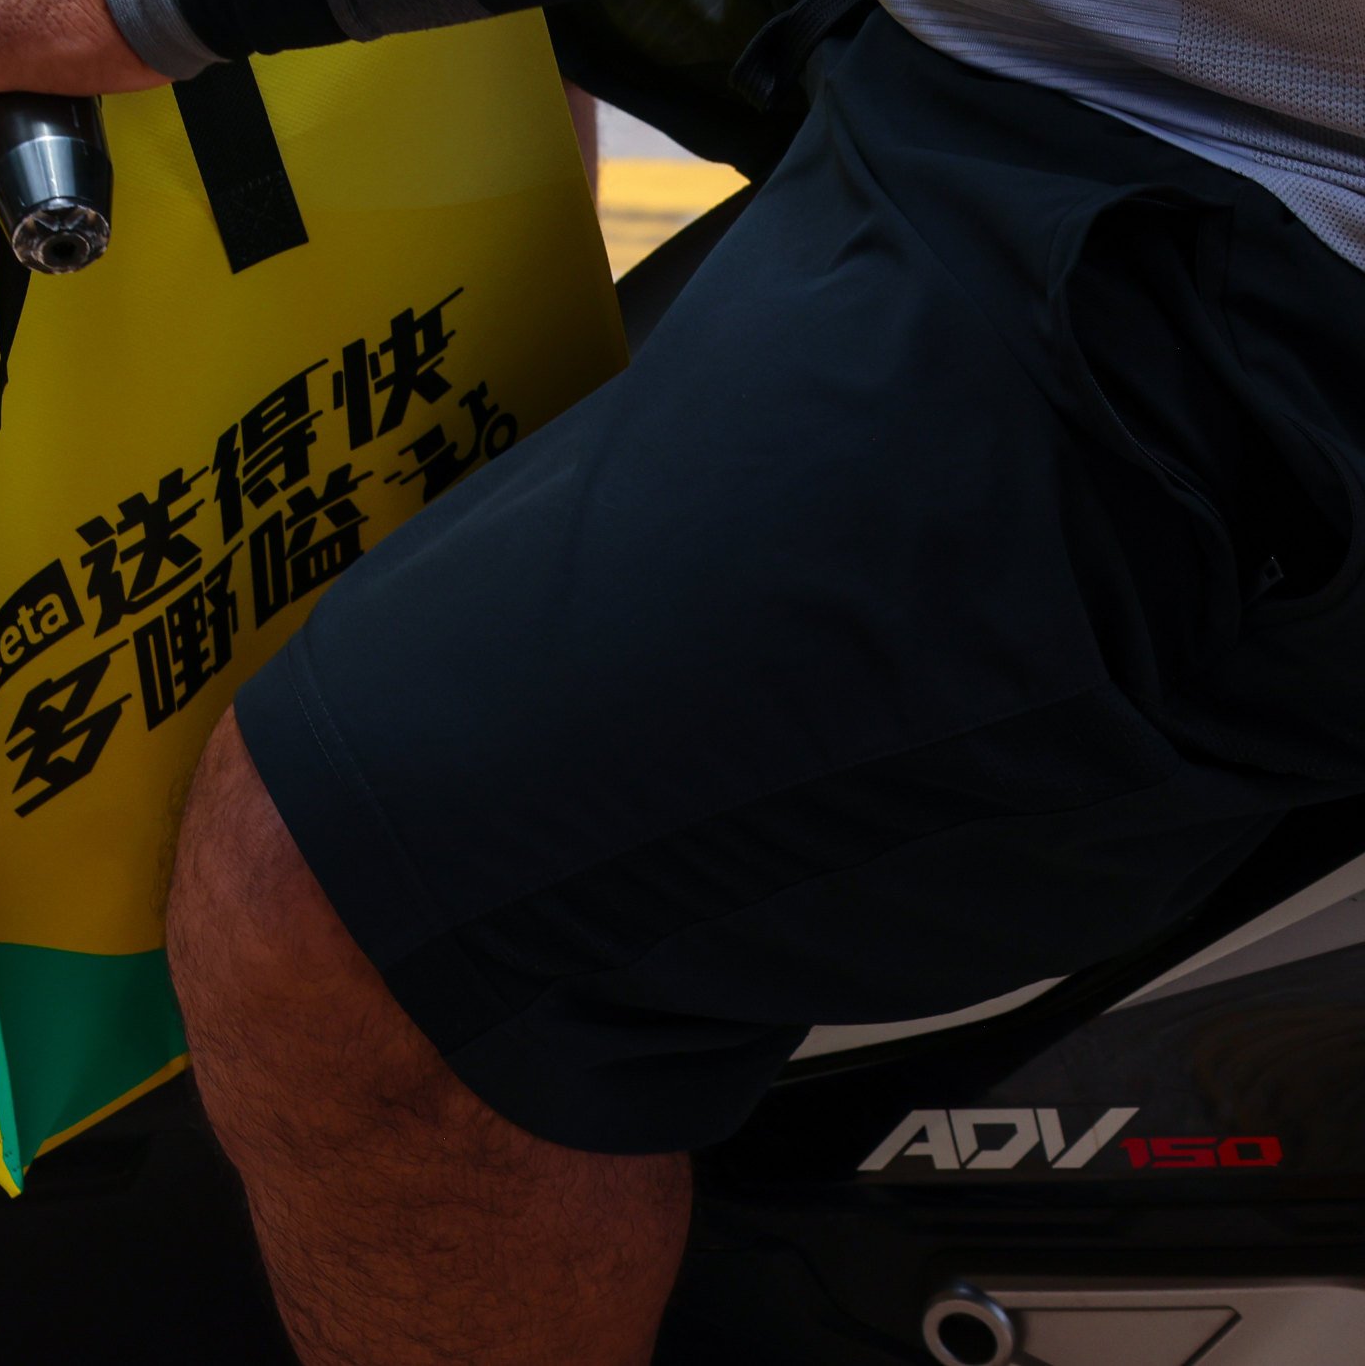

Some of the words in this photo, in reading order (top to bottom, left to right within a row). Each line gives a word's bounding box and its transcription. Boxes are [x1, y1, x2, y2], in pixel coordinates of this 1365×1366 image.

[76, 287, 465, 639] 送得快
[5, 463, 373, 818] 多嘢嗌
[856, 1107, 1141, 1172] ADV
[1118, 1134, 1284, 1170] 150
